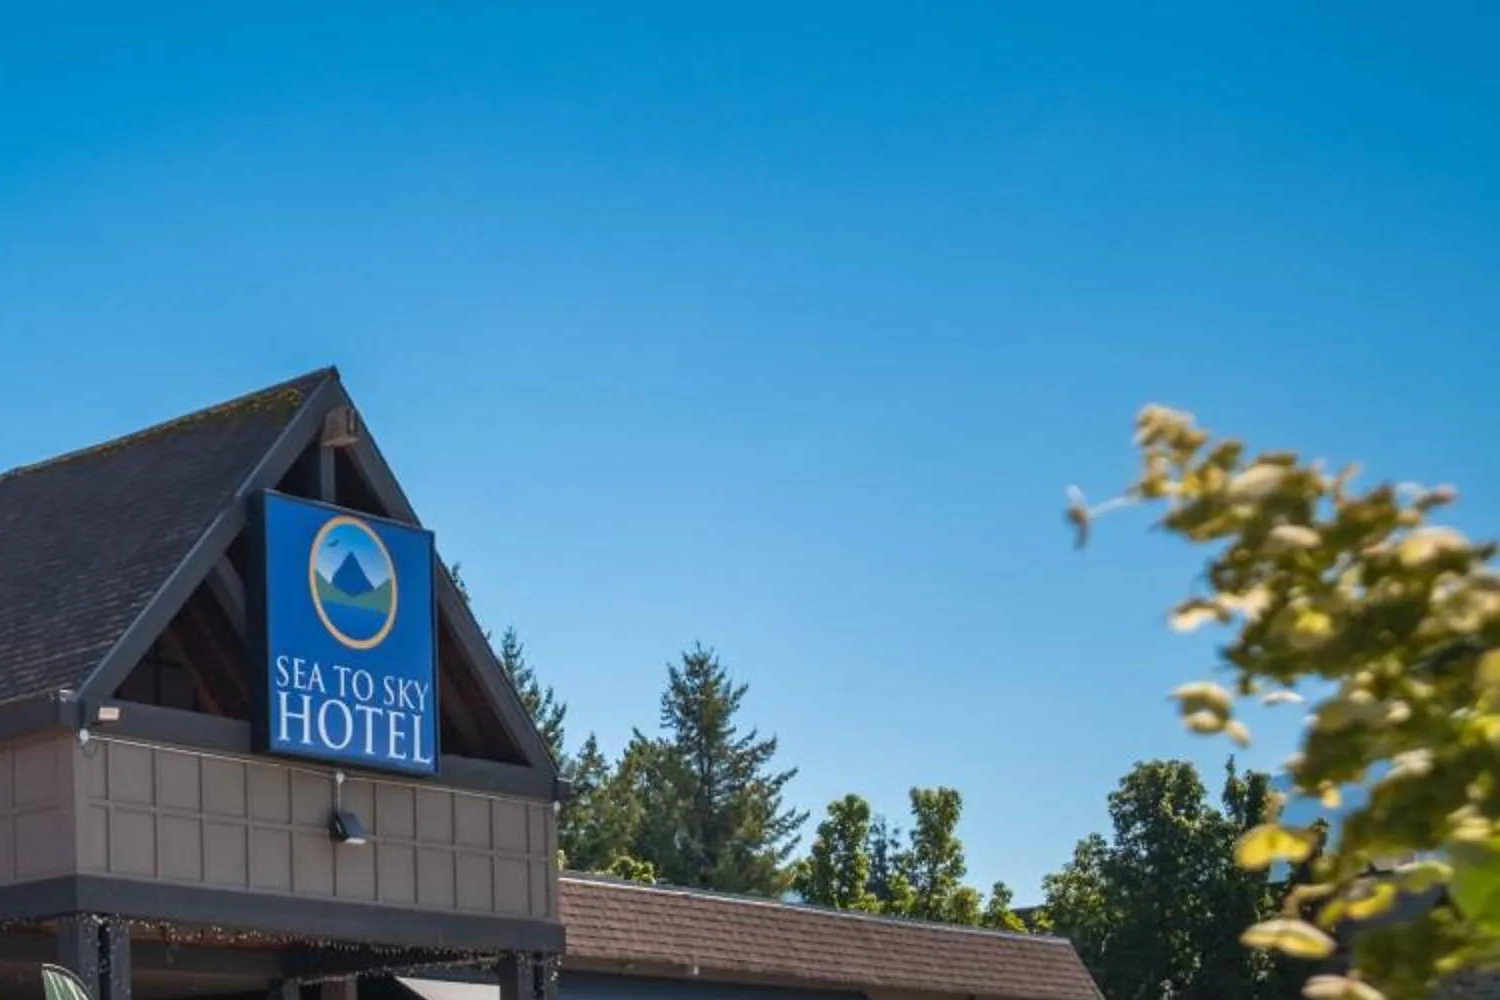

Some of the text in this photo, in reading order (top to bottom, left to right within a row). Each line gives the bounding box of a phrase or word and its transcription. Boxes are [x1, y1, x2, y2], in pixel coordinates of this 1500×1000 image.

[276, 655, 429, 712] SEA TO SKY
[276, 690, 433, 764] HOTEL
